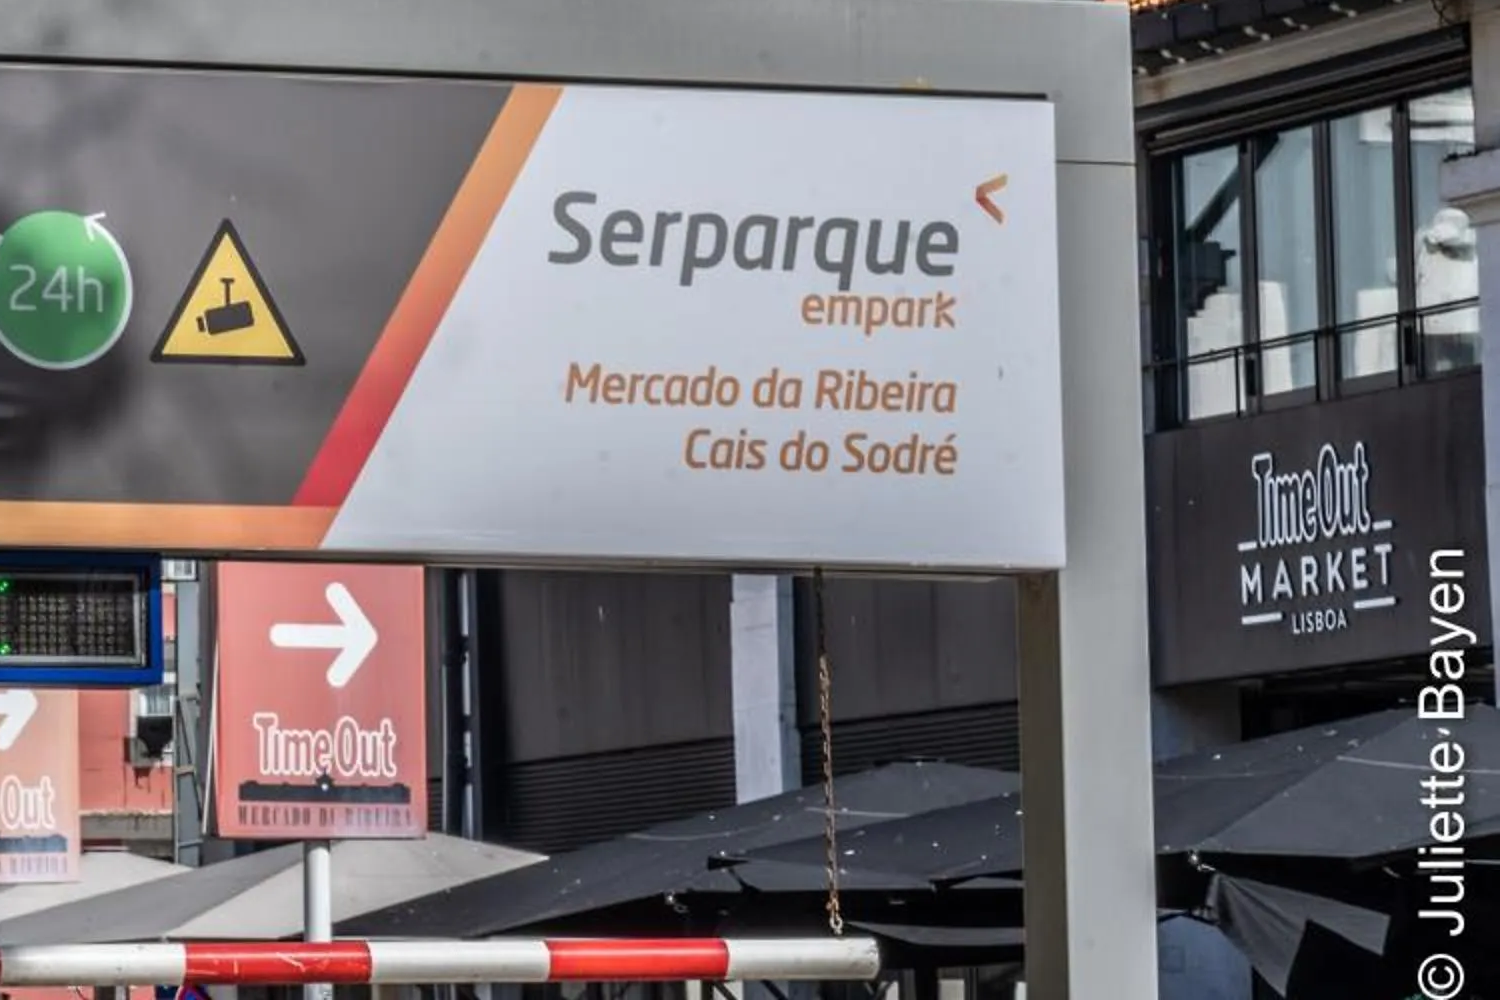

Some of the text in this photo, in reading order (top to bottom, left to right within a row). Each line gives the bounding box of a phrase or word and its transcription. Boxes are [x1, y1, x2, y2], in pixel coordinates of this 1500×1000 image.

[547, 190, 959, 291] Serparque
[9, 264, 104, 313] 24h
[800, 292, 957, 336] empark
[564, 362, 957, 413] Mercado da Ribeira
[683, 429, 958, 475] Cais do Sodré
[1240, 543, 1393, 605] MARKET
[1291, 609, 1348, 635] LISBOA
